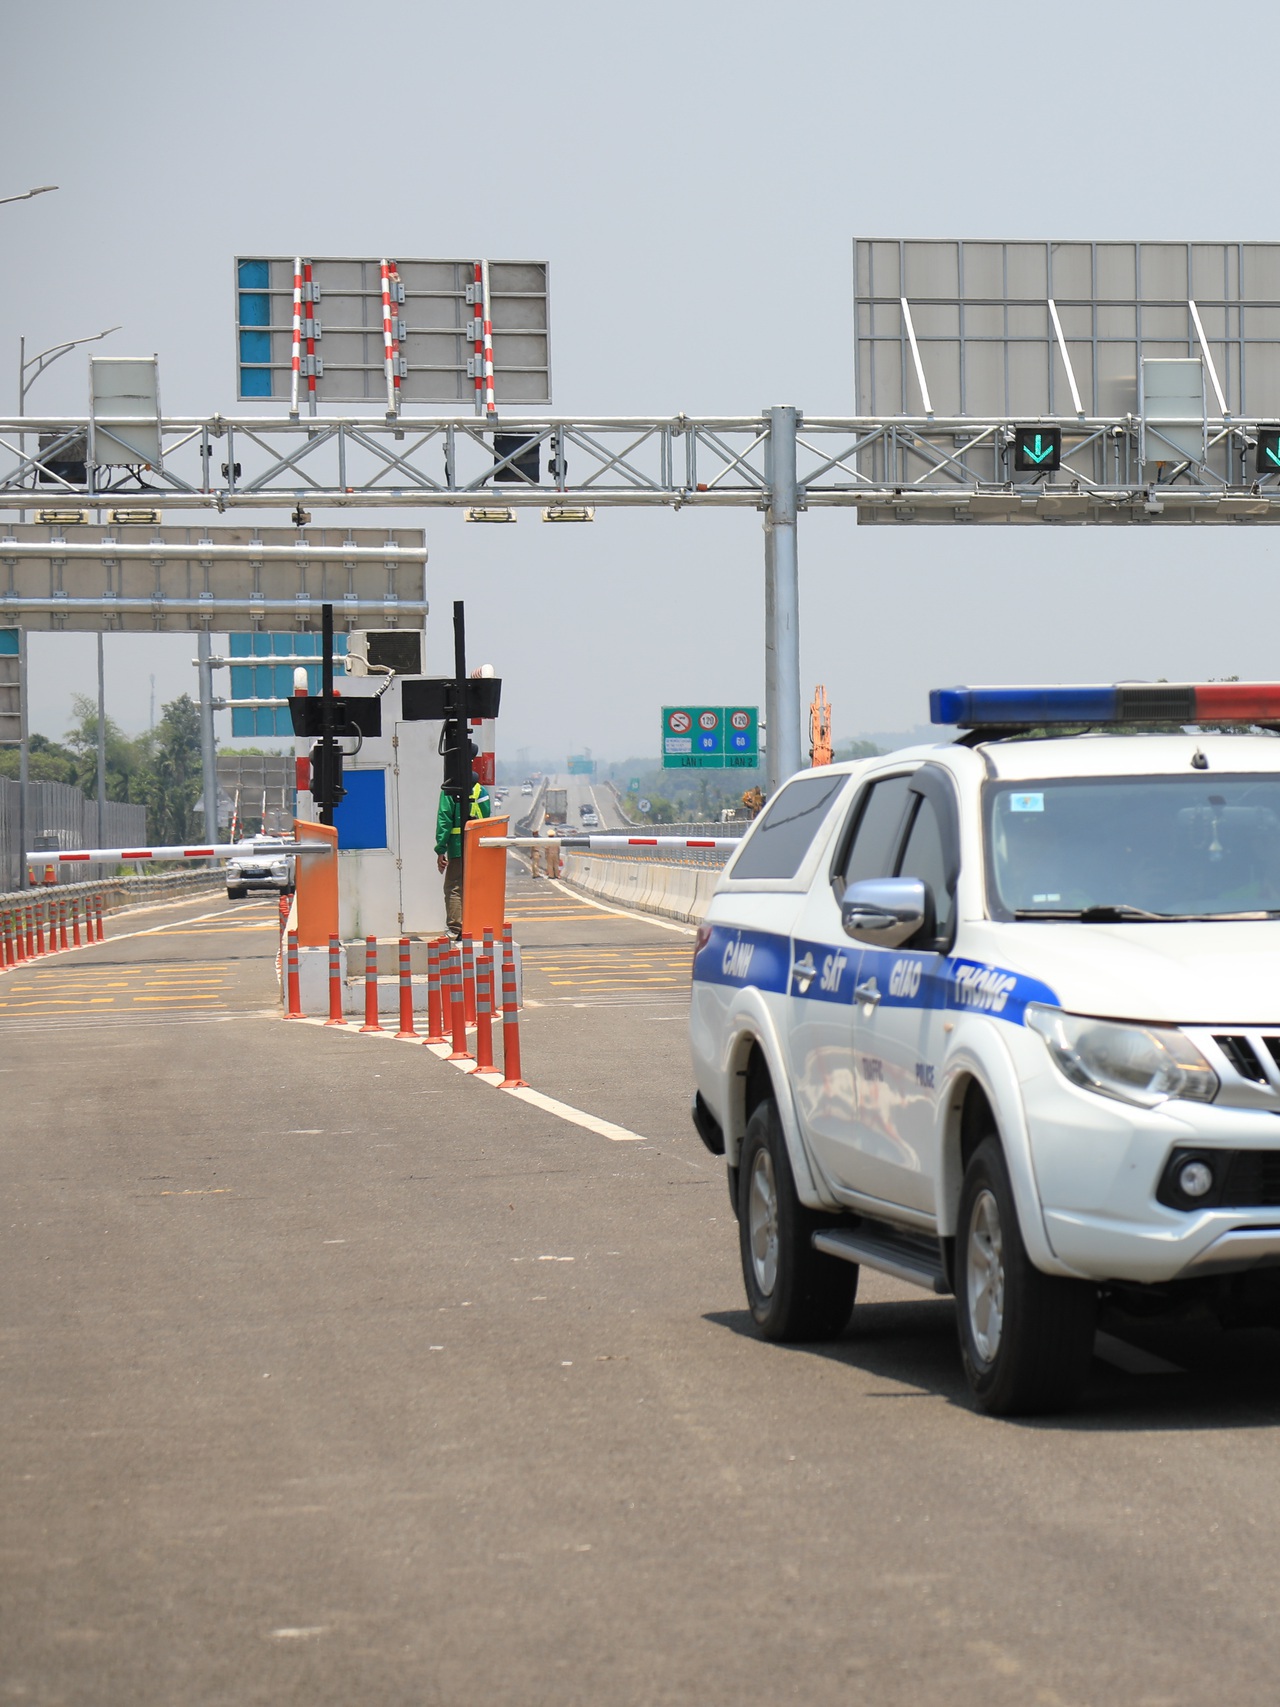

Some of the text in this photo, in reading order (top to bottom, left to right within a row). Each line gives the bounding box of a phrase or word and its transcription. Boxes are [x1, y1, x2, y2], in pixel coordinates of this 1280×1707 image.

[702, 716, 715, 725] 120
[734, 716, 747, 725] 120
[748, 757, 753, 767] 2
[820, 948, 848, 993] SÁT
[888, 959, 923, 999] GIAO
[954, 964, 1018, 1013] THÔNG
[915, 1062, 935, 1089] POLICE
